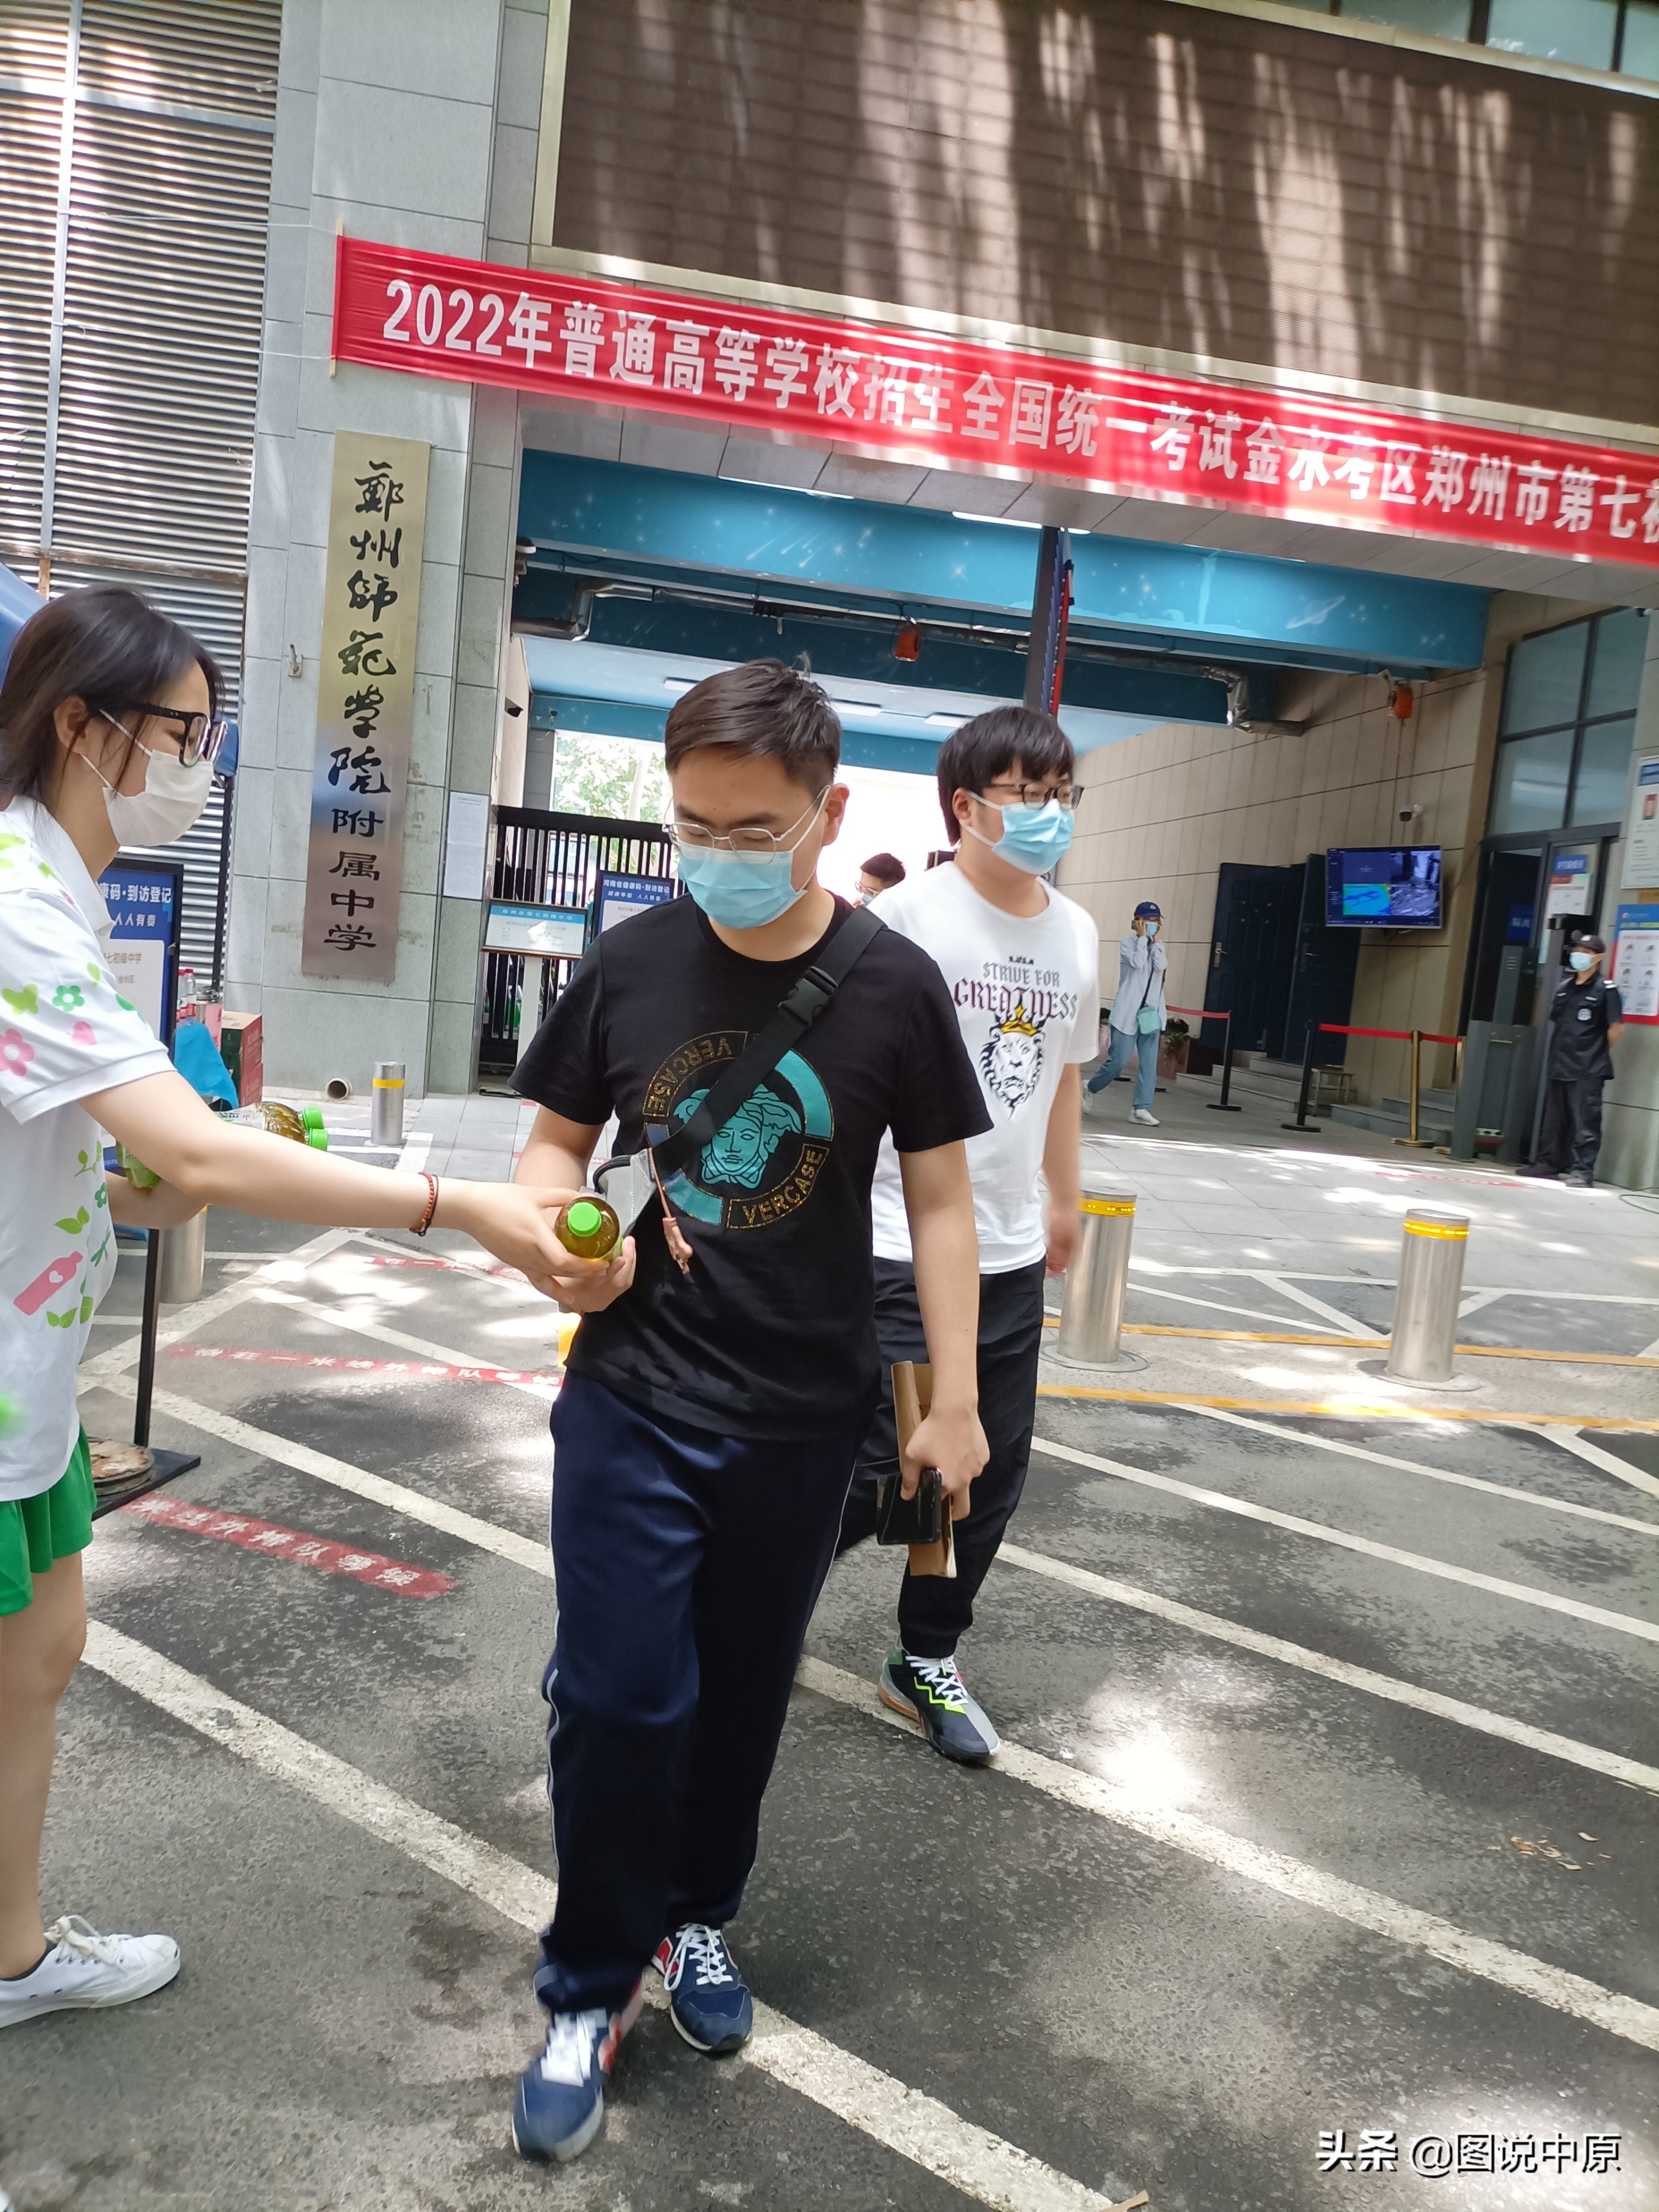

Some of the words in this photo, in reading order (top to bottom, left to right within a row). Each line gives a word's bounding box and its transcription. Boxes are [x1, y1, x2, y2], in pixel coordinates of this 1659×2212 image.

[953, 977, 1079, 1021] GREATNESS
[1035, 968, 1061, 988] FOR
[742, 1149, 823, 1224] VERCASE
